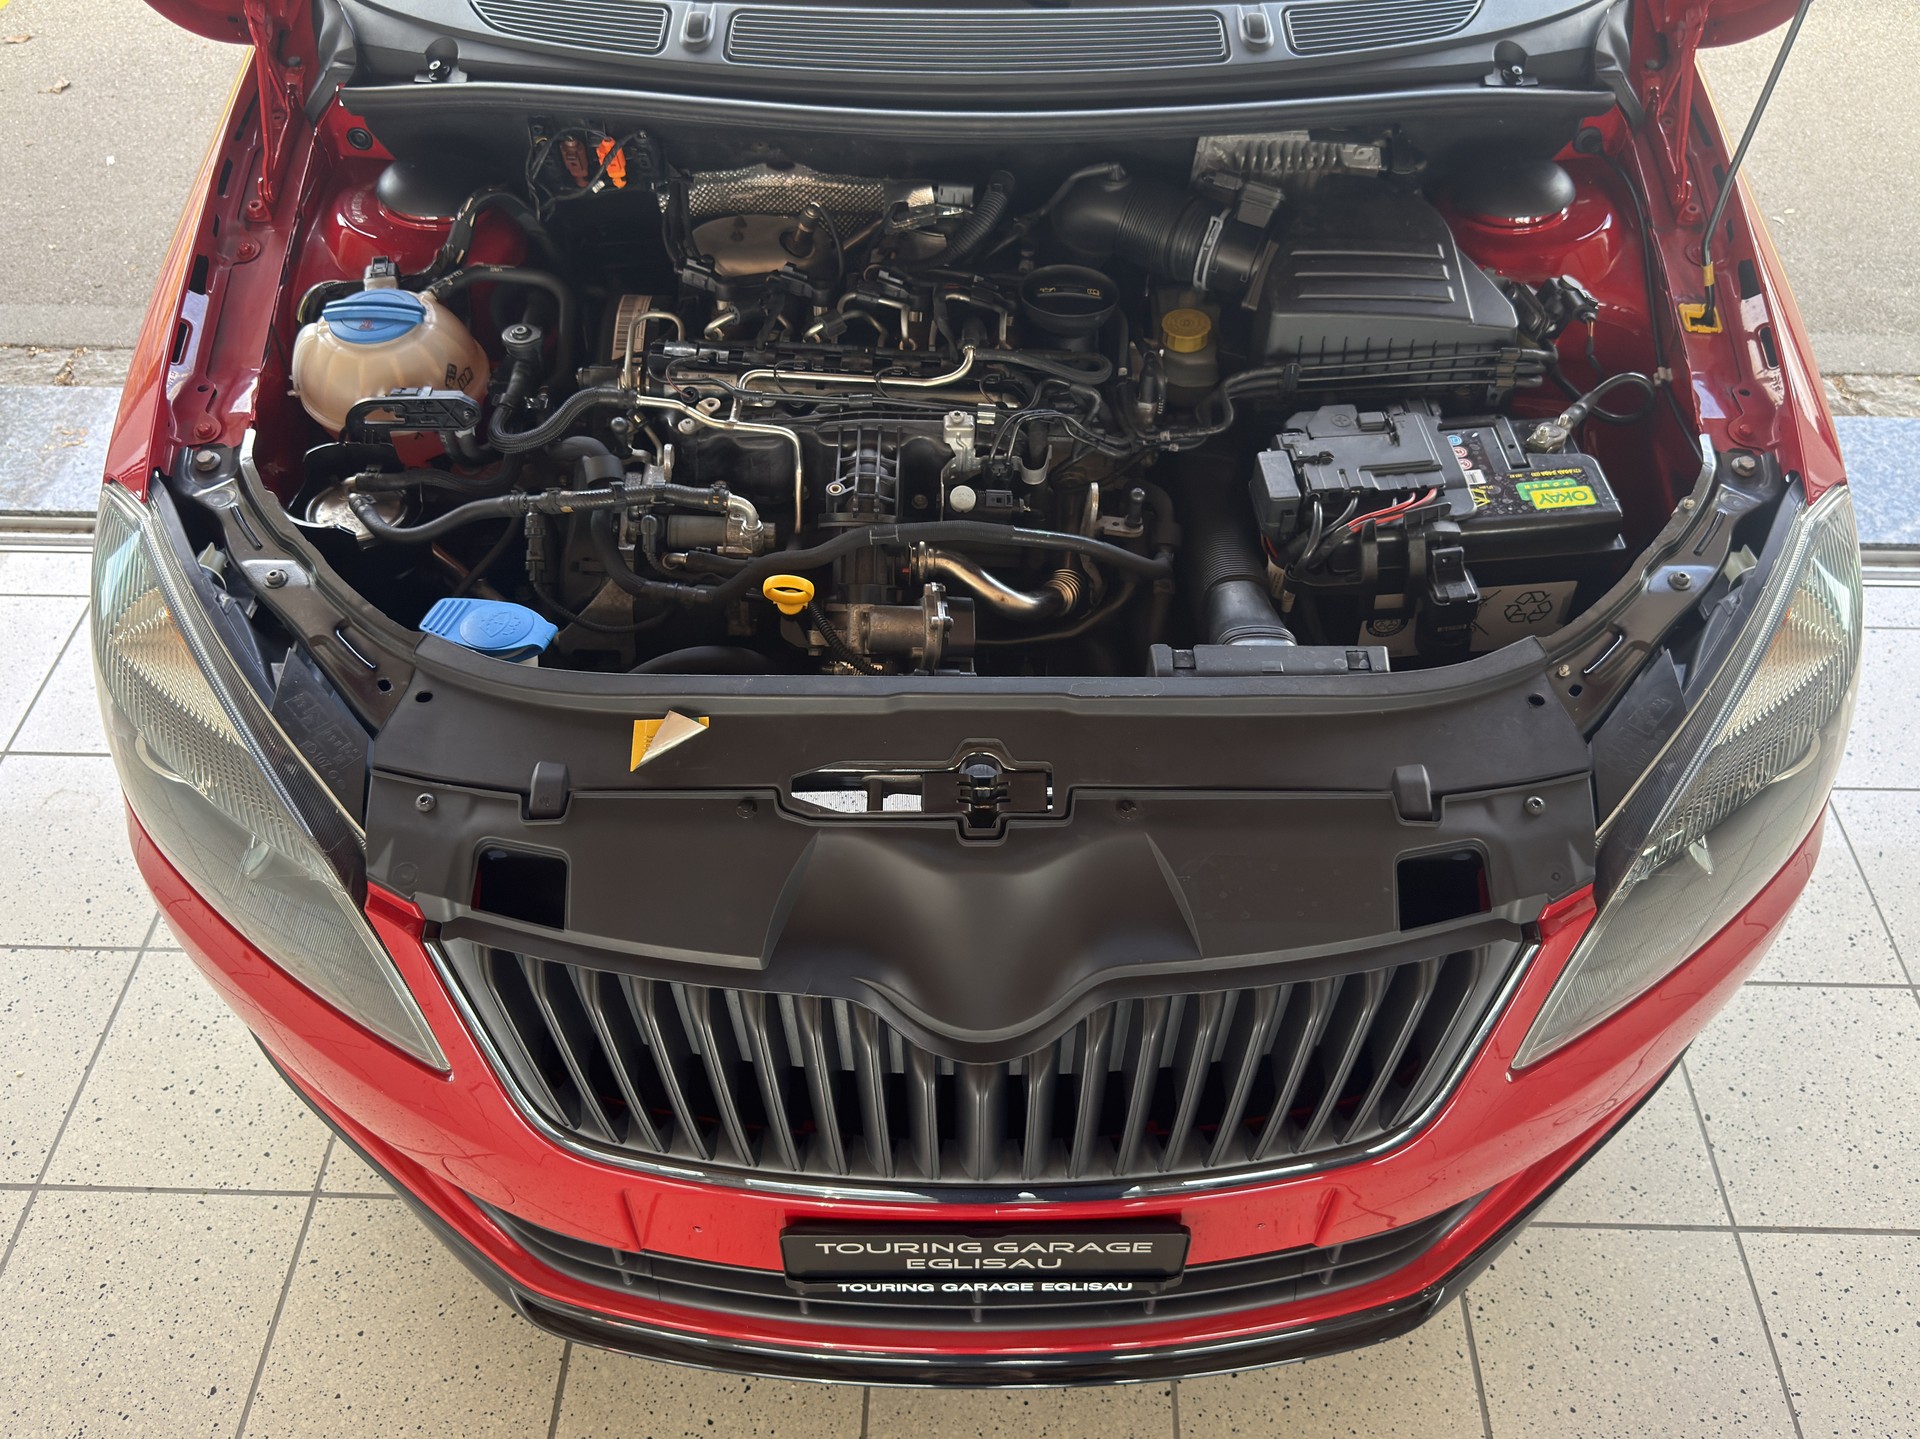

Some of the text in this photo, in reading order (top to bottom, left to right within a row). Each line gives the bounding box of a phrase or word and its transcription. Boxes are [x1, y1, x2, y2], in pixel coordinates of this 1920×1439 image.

[1524, 481, 1570, 490] POWER
[1539, 490, 1588, 505] OKAY
[815, 1242, 1153, 1255] TOURING GARAGE
[906, 1258, 1062, 1270] EGLISAU
[837, 1283, 1133, 1293] TOURING GARAGE EGLISAU
